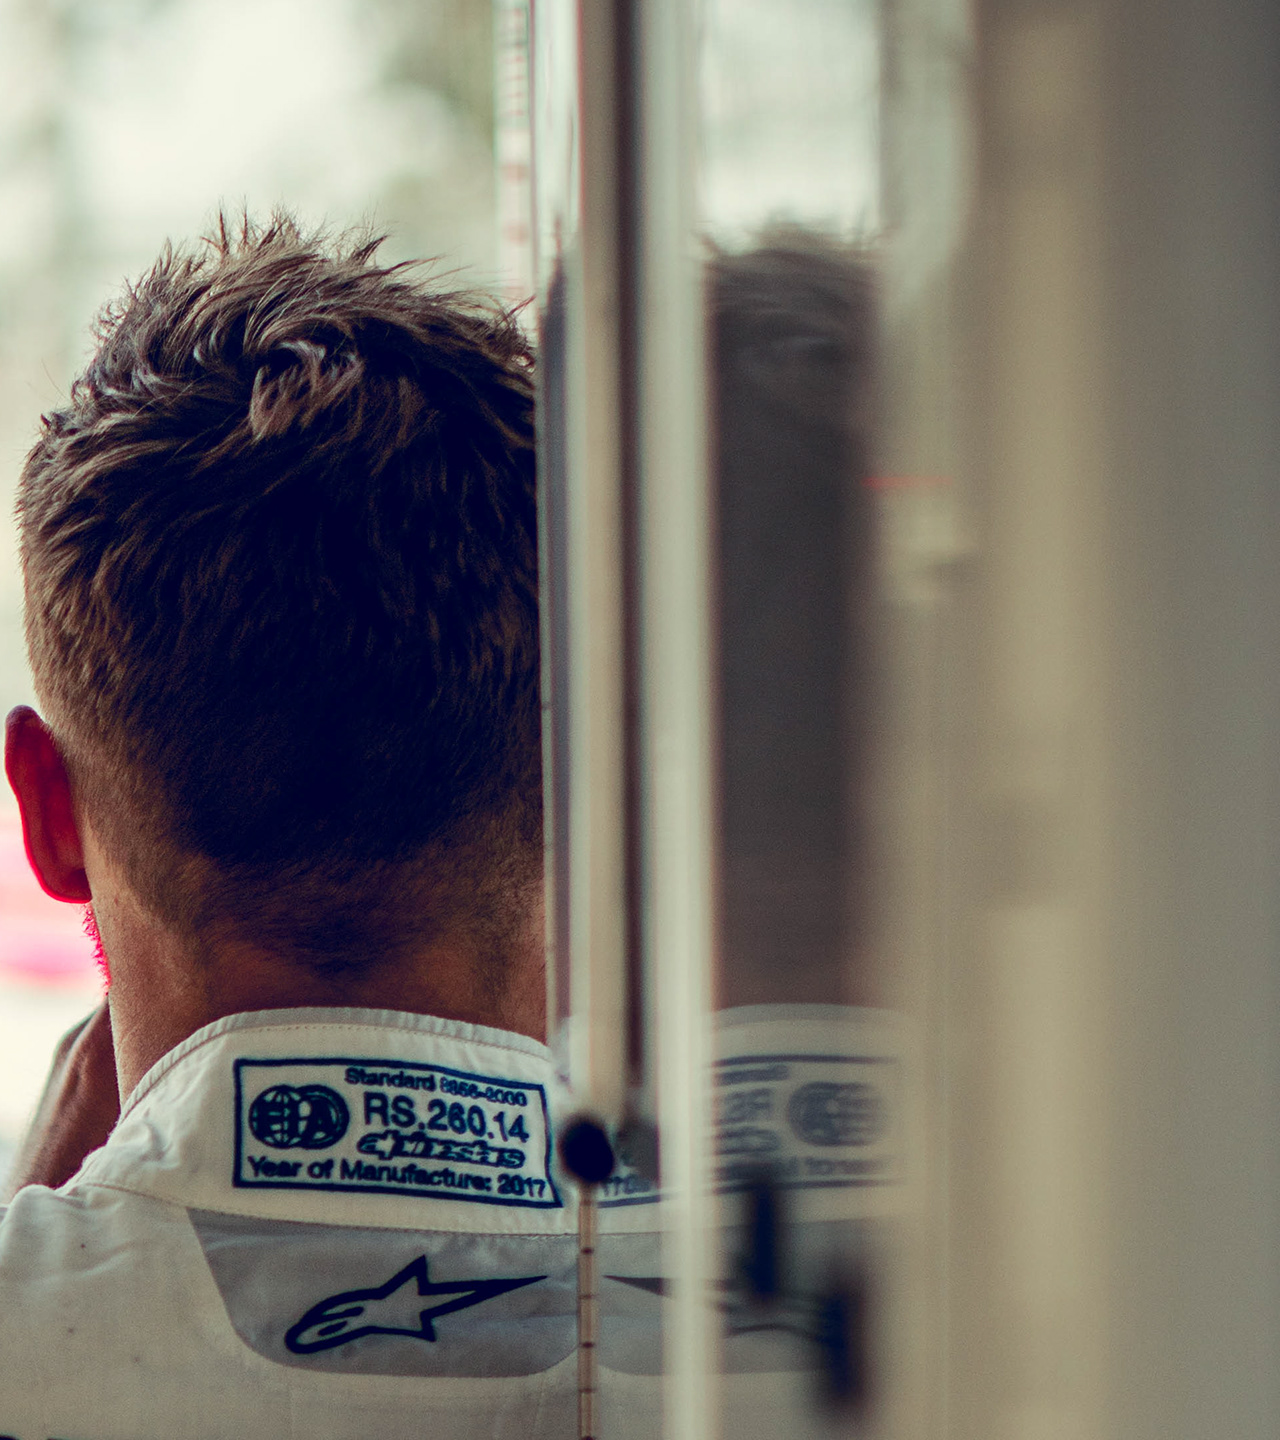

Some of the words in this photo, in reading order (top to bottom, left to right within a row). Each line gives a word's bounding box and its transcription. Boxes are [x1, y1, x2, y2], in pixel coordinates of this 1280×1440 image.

[345, 1067, 435, 1092] Standard
[363, 1091, 530, 1143] RS.260.14
[247, 1155, 303, 1178] Year
[307, 1158, 334, 1179] of
[340, 1158, 492, 1192] Manufacture:
[497, 1172, 546, 1199] 2017
